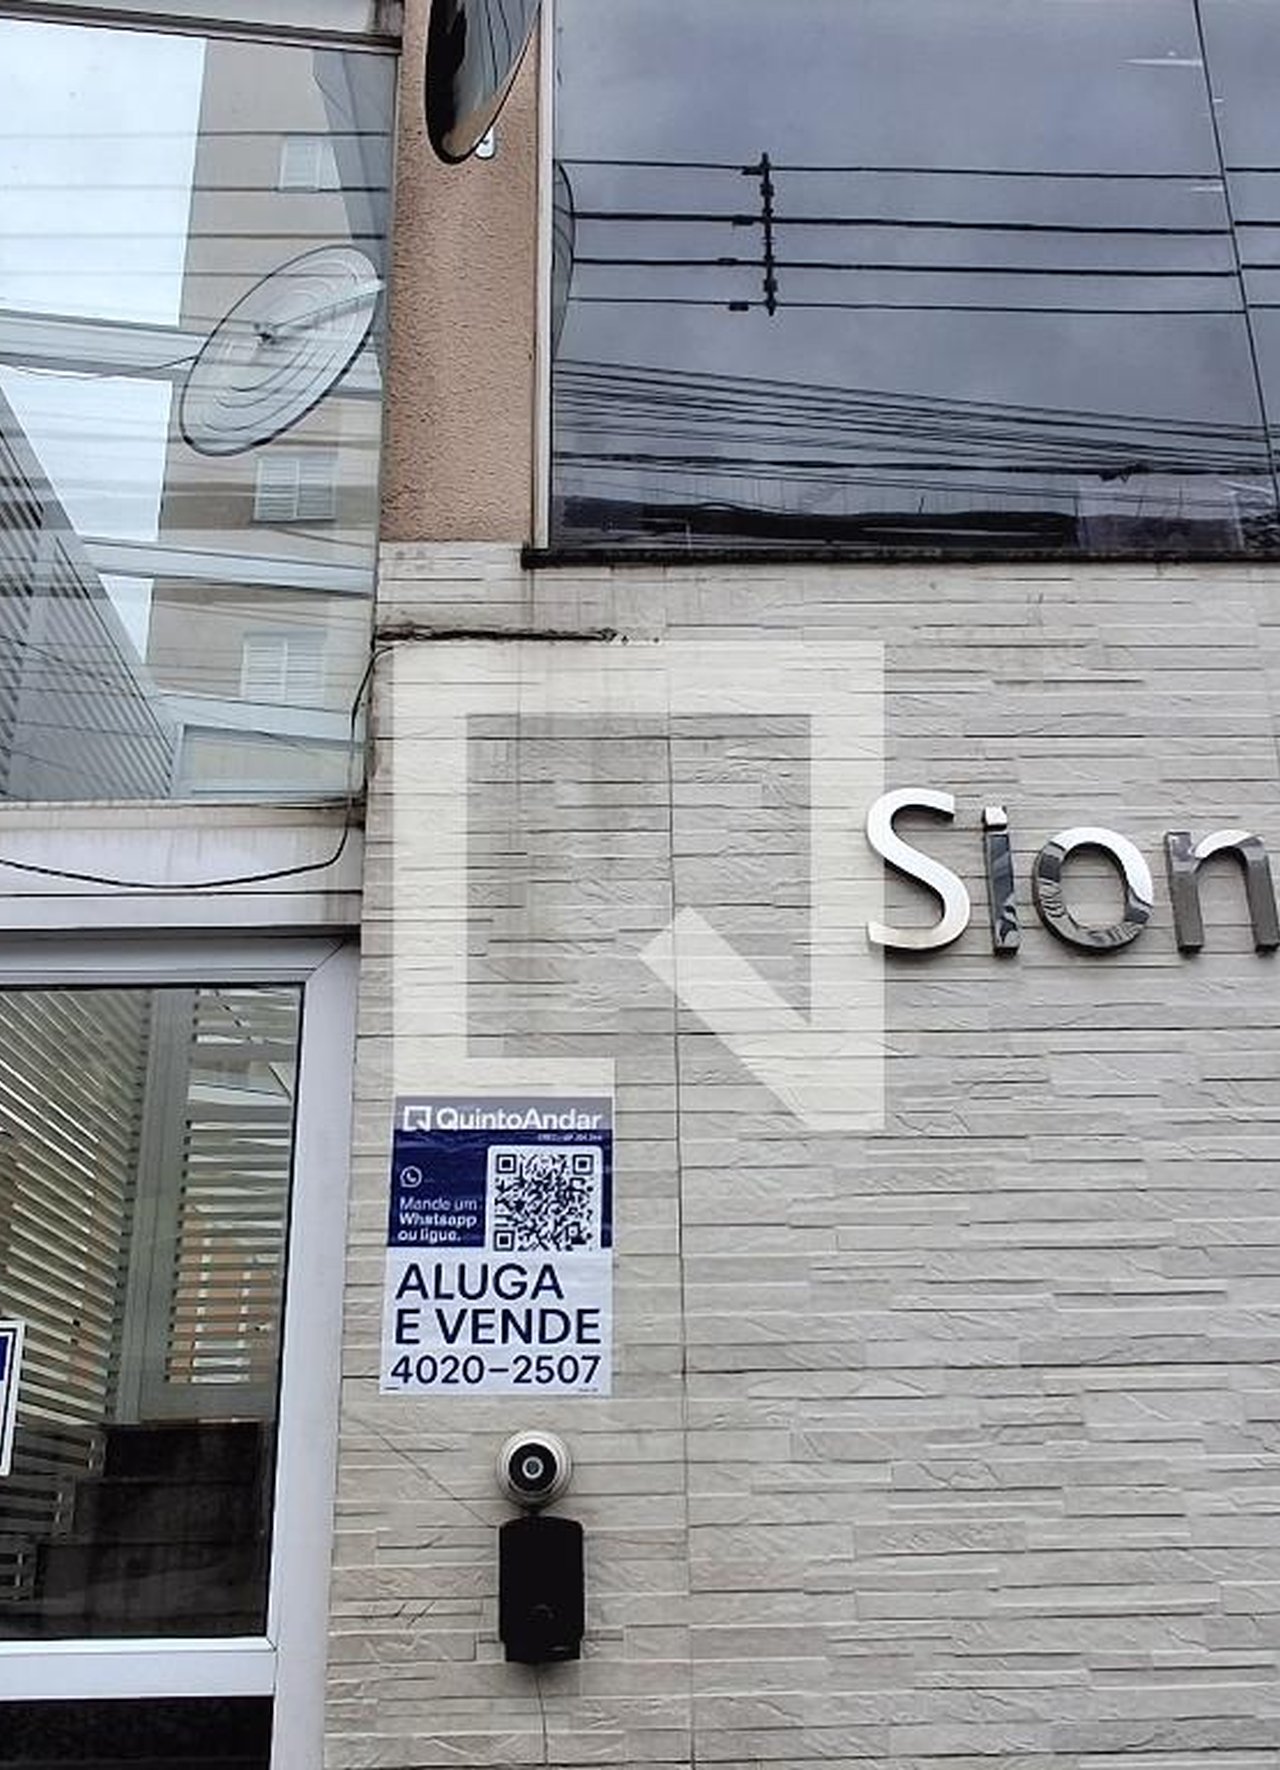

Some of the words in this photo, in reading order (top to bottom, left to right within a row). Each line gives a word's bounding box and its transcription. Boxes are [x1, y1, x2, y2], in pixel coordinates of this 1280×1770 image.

[436, 1107, 603, 1131] QuintoAndar
[399, 1196, 452, 1211] Mande
[454, 1199, 478, 1211] um
[399, 1212, 478, 1230] Whatsapp
[397, 1229, 418, 1242] ou
[394, 1262, 565, 1301] ALUGA
[394, 1307, 421, 1345] E
[434, 1307, 602, 1345] VENDE
[390, 1354, 602, 1384] 4020-2507
